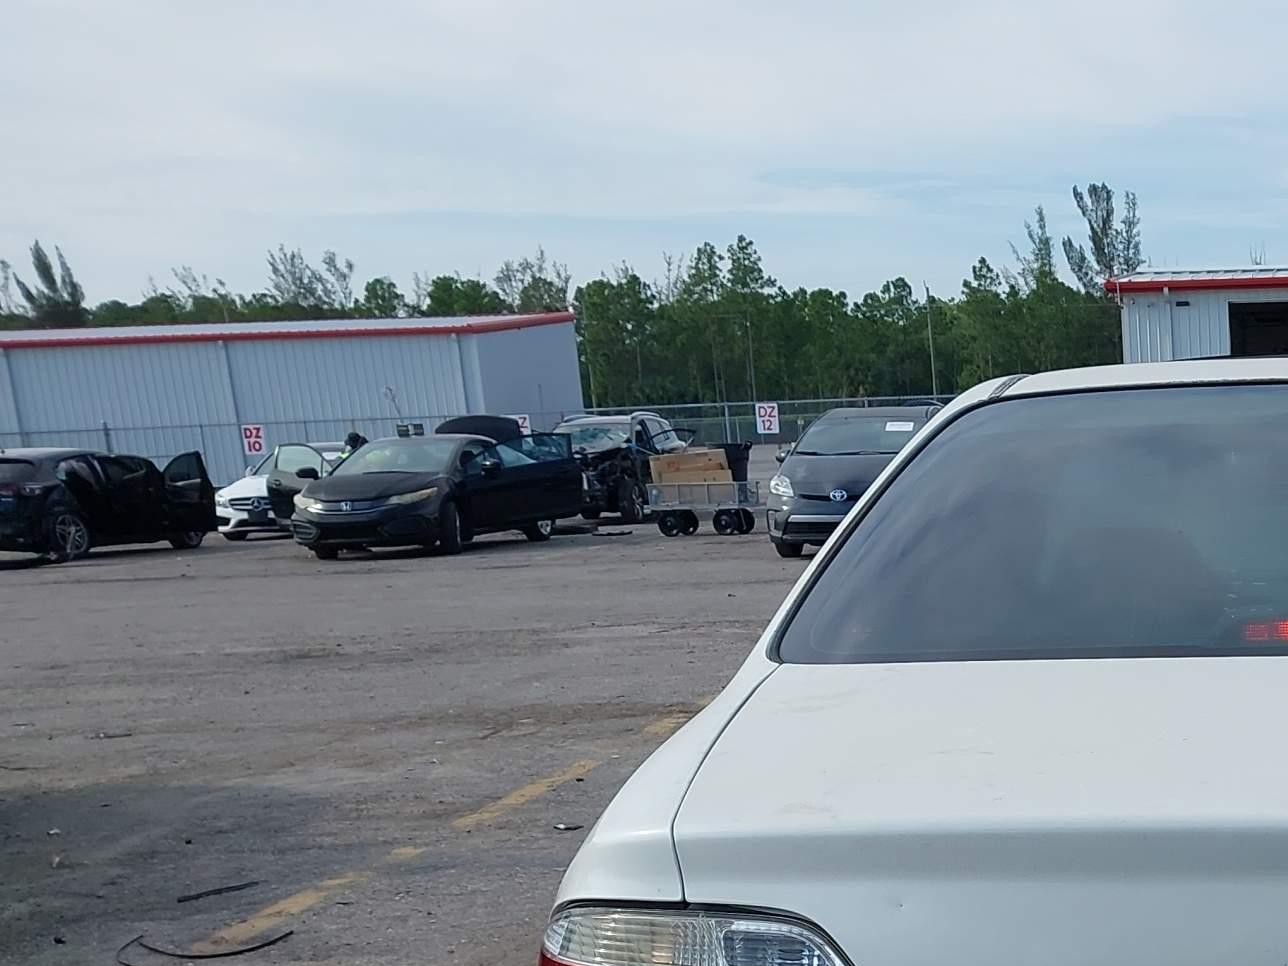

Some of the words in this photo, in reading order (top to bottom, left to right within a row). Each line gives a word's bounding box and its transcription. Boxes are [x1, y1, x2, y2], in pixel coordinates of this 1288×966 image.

[758, 406, 776, 418] DZ
[518, 416, 528, 428] Z
[762, 419, 773, 431] 12
[243, 427, 262, 439] DZ
[247, 440, 262, 452] 10
